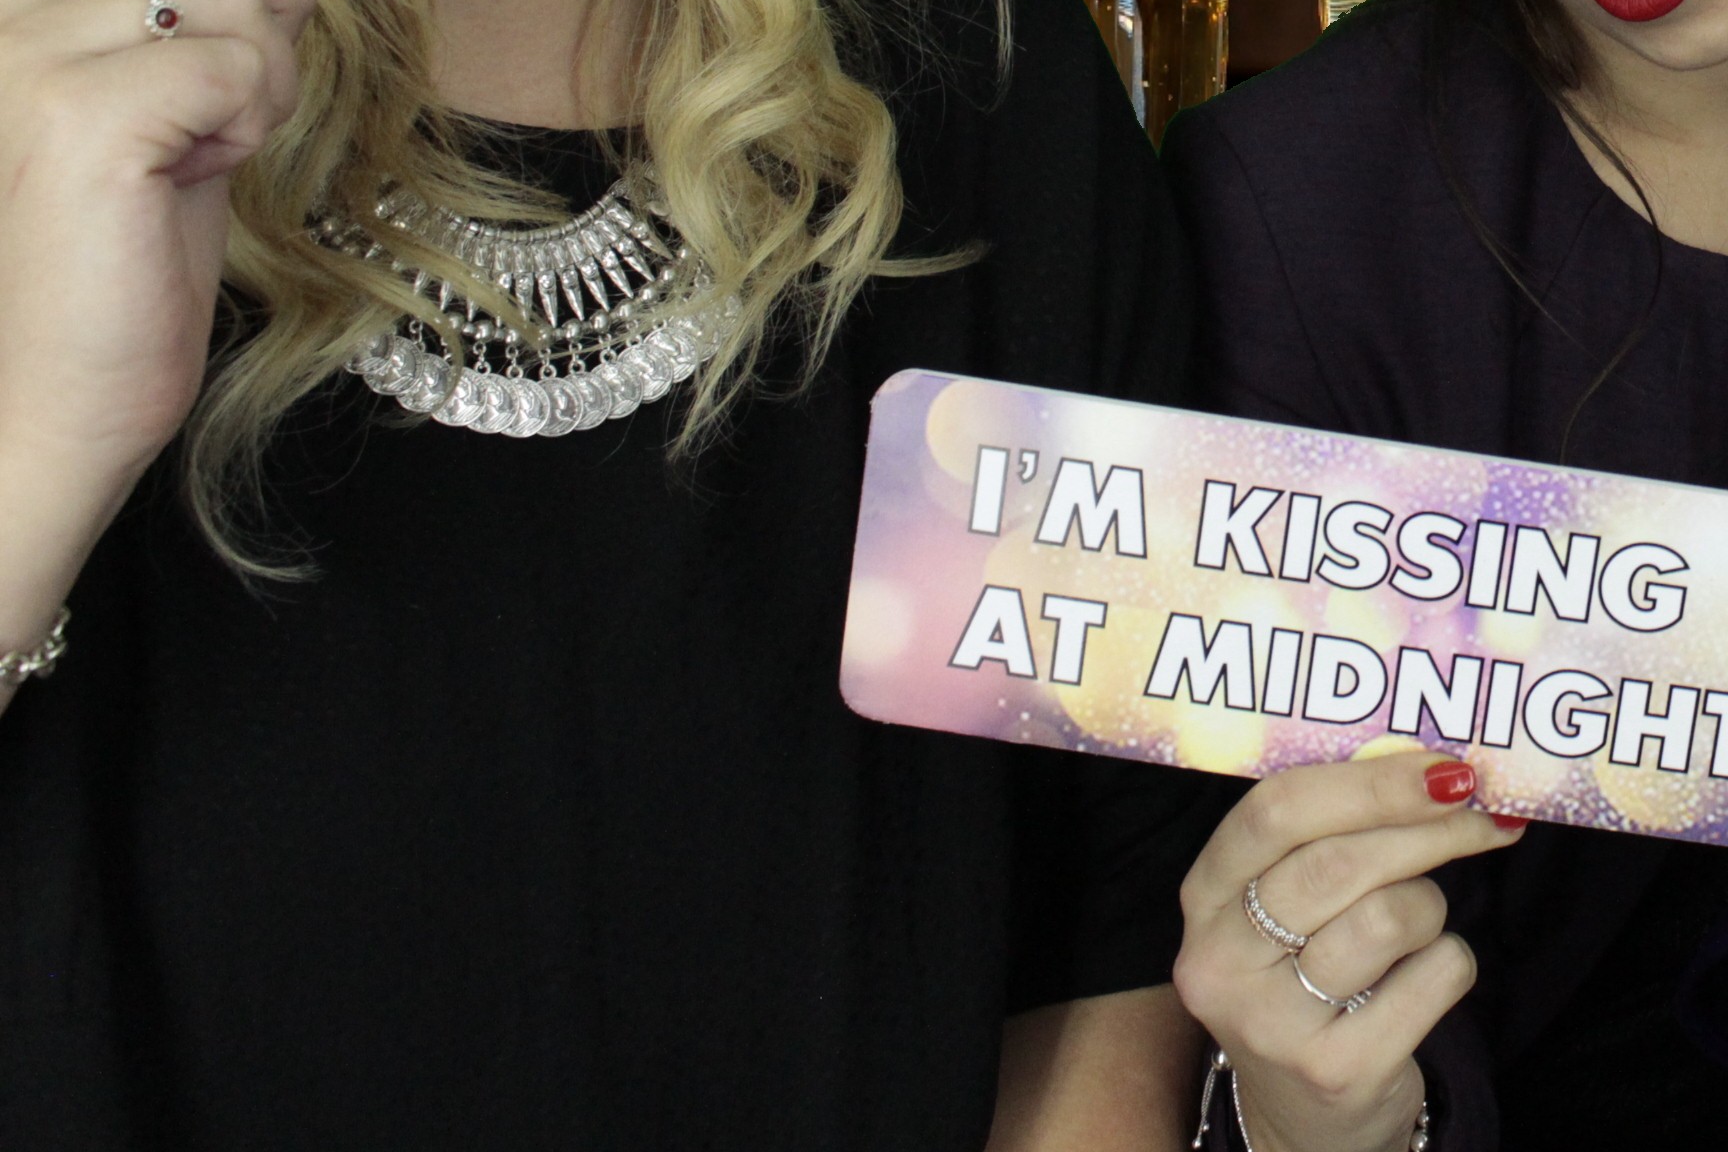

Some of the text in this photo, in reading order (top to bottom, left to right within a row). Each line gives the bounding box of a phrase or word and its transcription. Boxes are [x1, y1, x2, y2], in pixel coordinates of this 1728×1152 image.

[968, 444, 1148, 559] I'M
[1194, 479, 1690, 634] KISSING
[948, 584, 1108, 686] AT
